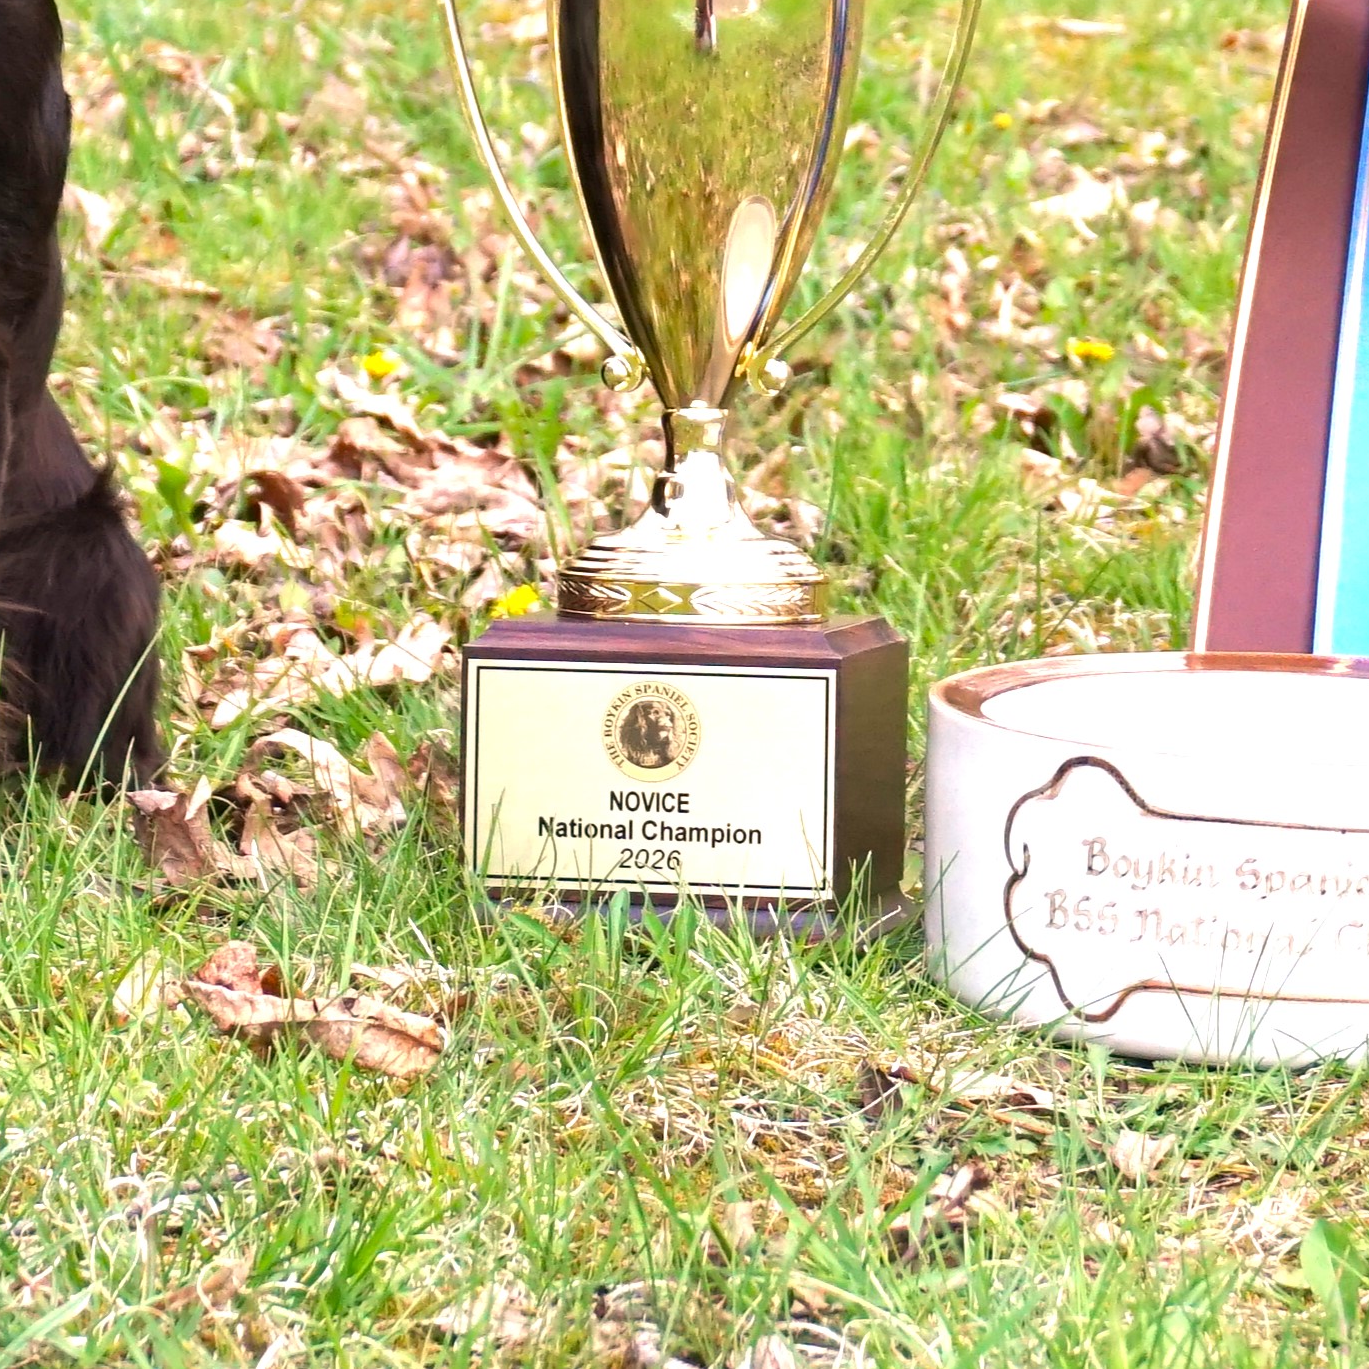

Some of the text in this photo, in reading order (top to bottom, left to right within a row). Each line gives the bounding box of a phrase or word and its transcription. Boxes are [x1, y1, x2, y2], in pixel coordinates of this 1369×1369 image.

[603, 684, 699, 771] THE BOYKIN SPANIEL SOCIETY
[609, 790, 690, 813] NOVICE
[538, 816, 762, 849] National Champion
[619, 848, 682, 870] 2026
[1081, 836, 1219, 891] Boykin
[1043, 888, 1119, 936] BSS
